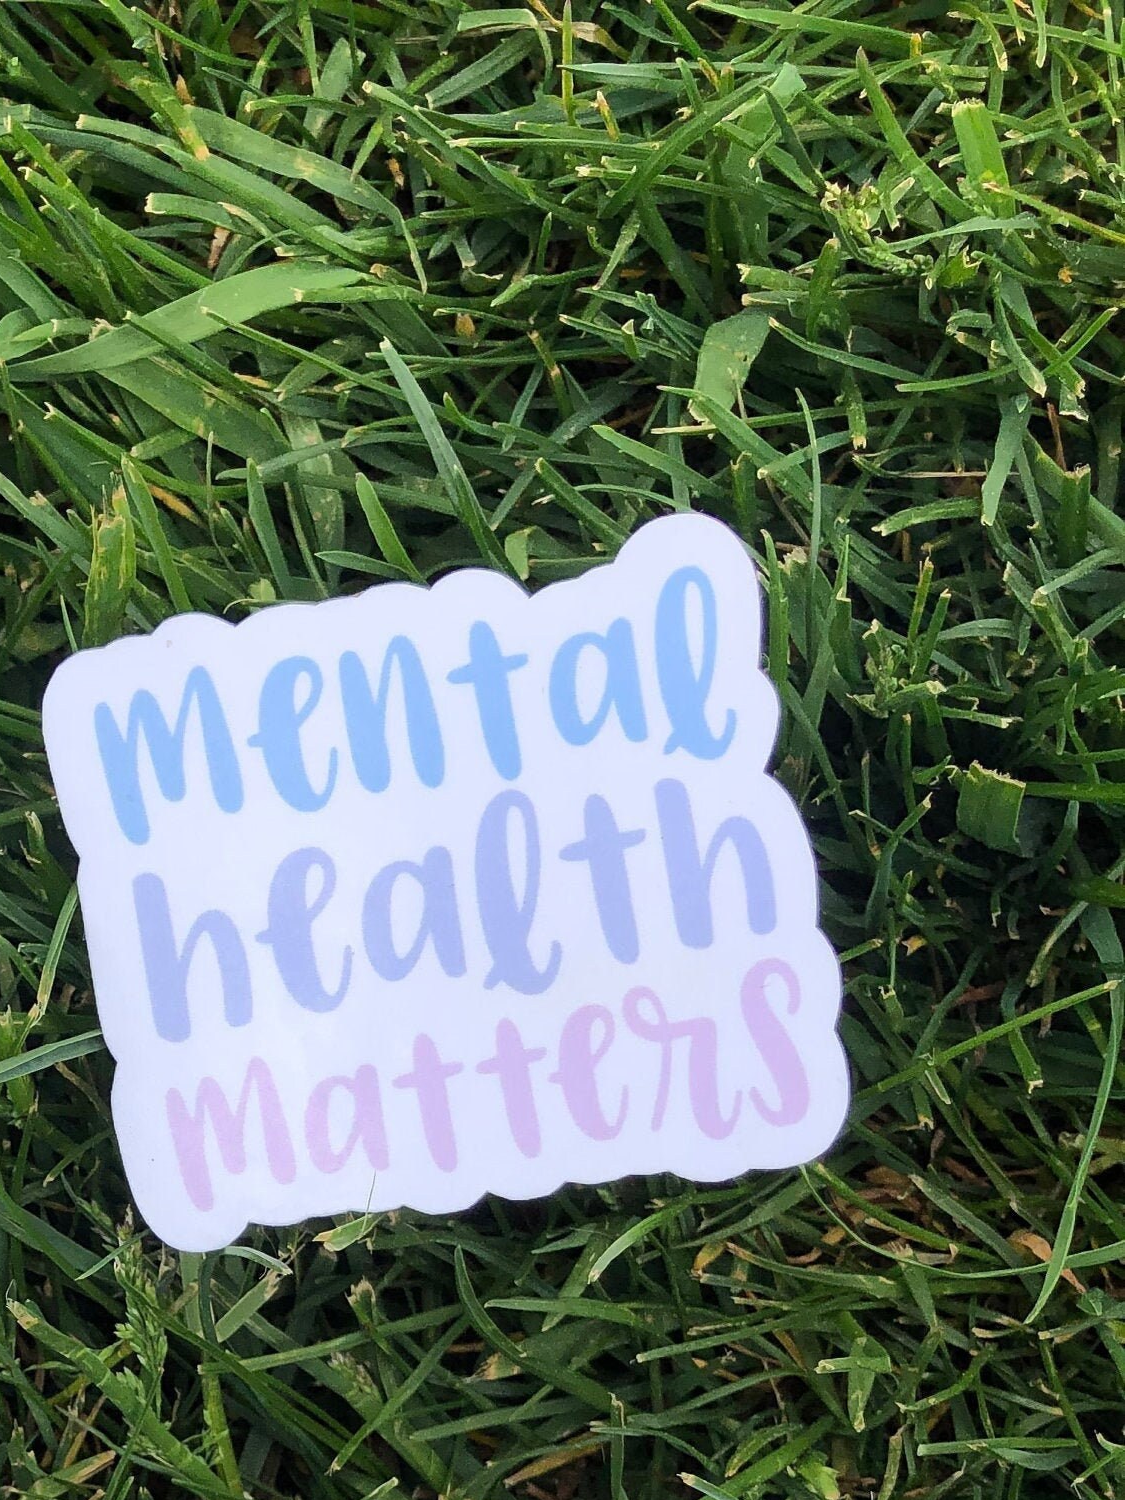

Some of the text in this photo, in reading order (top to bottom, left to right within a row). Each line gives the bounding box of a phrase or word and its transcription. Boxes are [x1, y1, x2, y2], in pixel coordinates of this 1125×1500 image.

[93, 565, 737, 846] mental
[132, 777, 778, 1044] health
[164, 957, 811, 1213] matters
